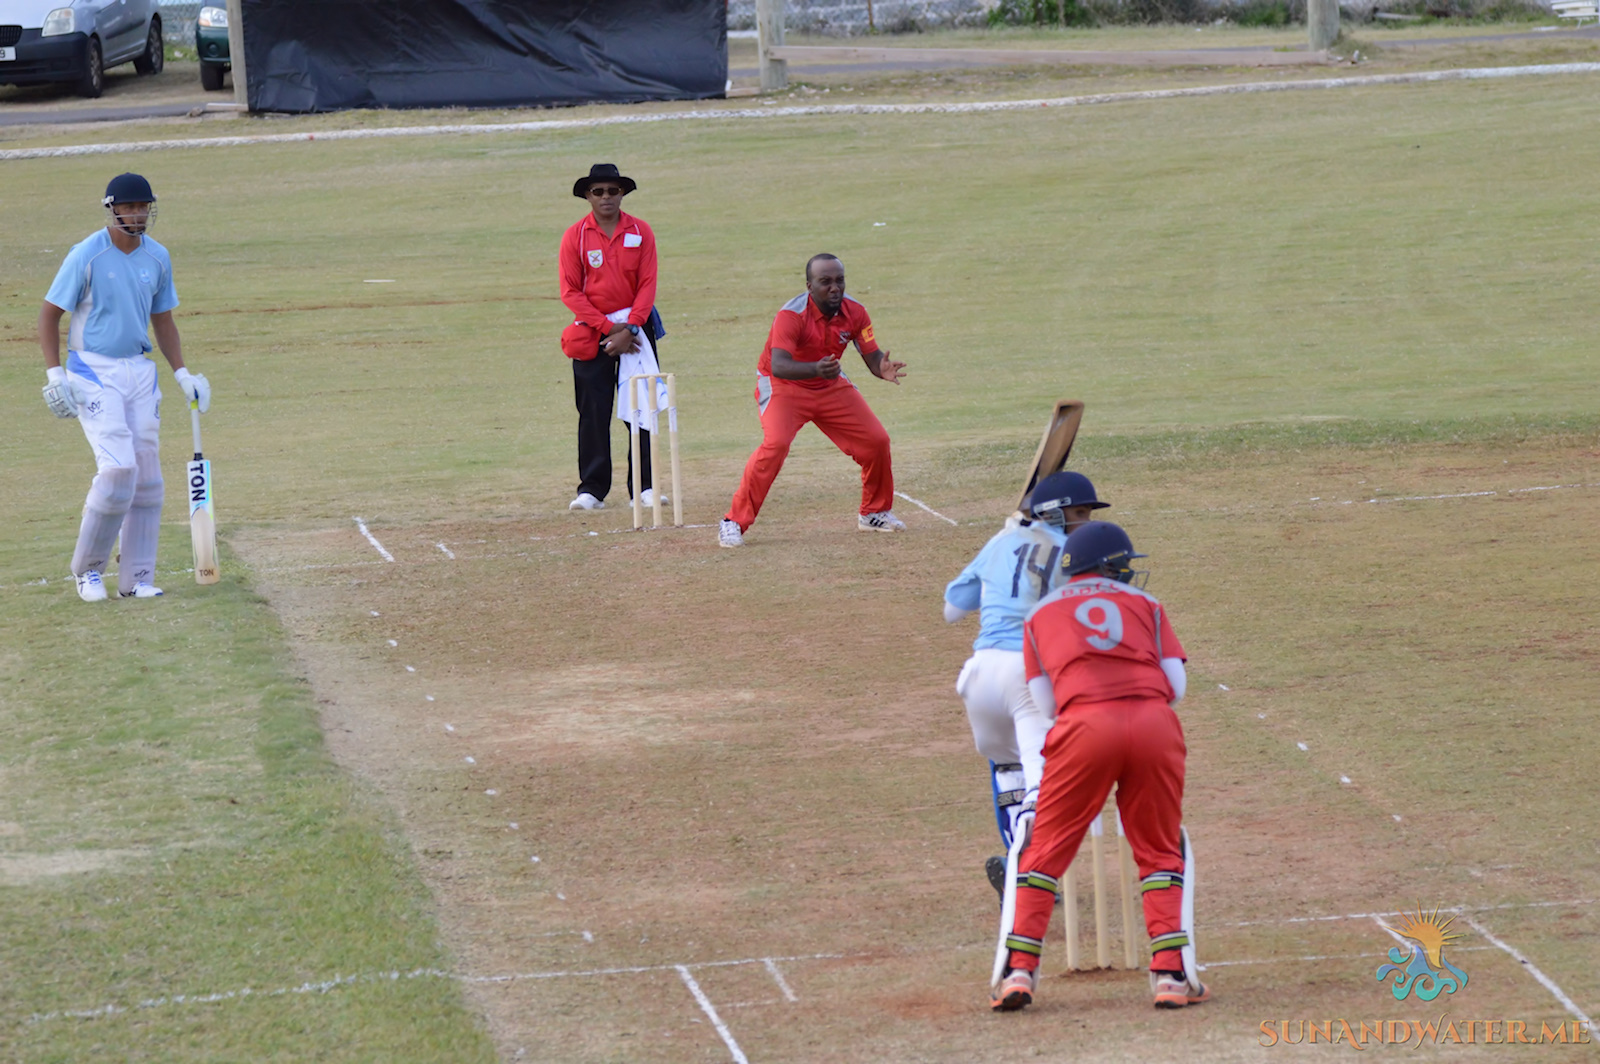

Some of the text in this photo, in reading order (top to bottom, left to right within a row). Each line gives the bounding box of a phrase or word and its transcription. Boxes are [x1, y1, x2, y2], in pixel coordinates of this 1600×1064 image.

[190, 463, 206, 502] TON
[199, 569, 214, 577] TON
[1011, 543, 1061, 600] 14
[1075, 598, 1124, 651] 9
